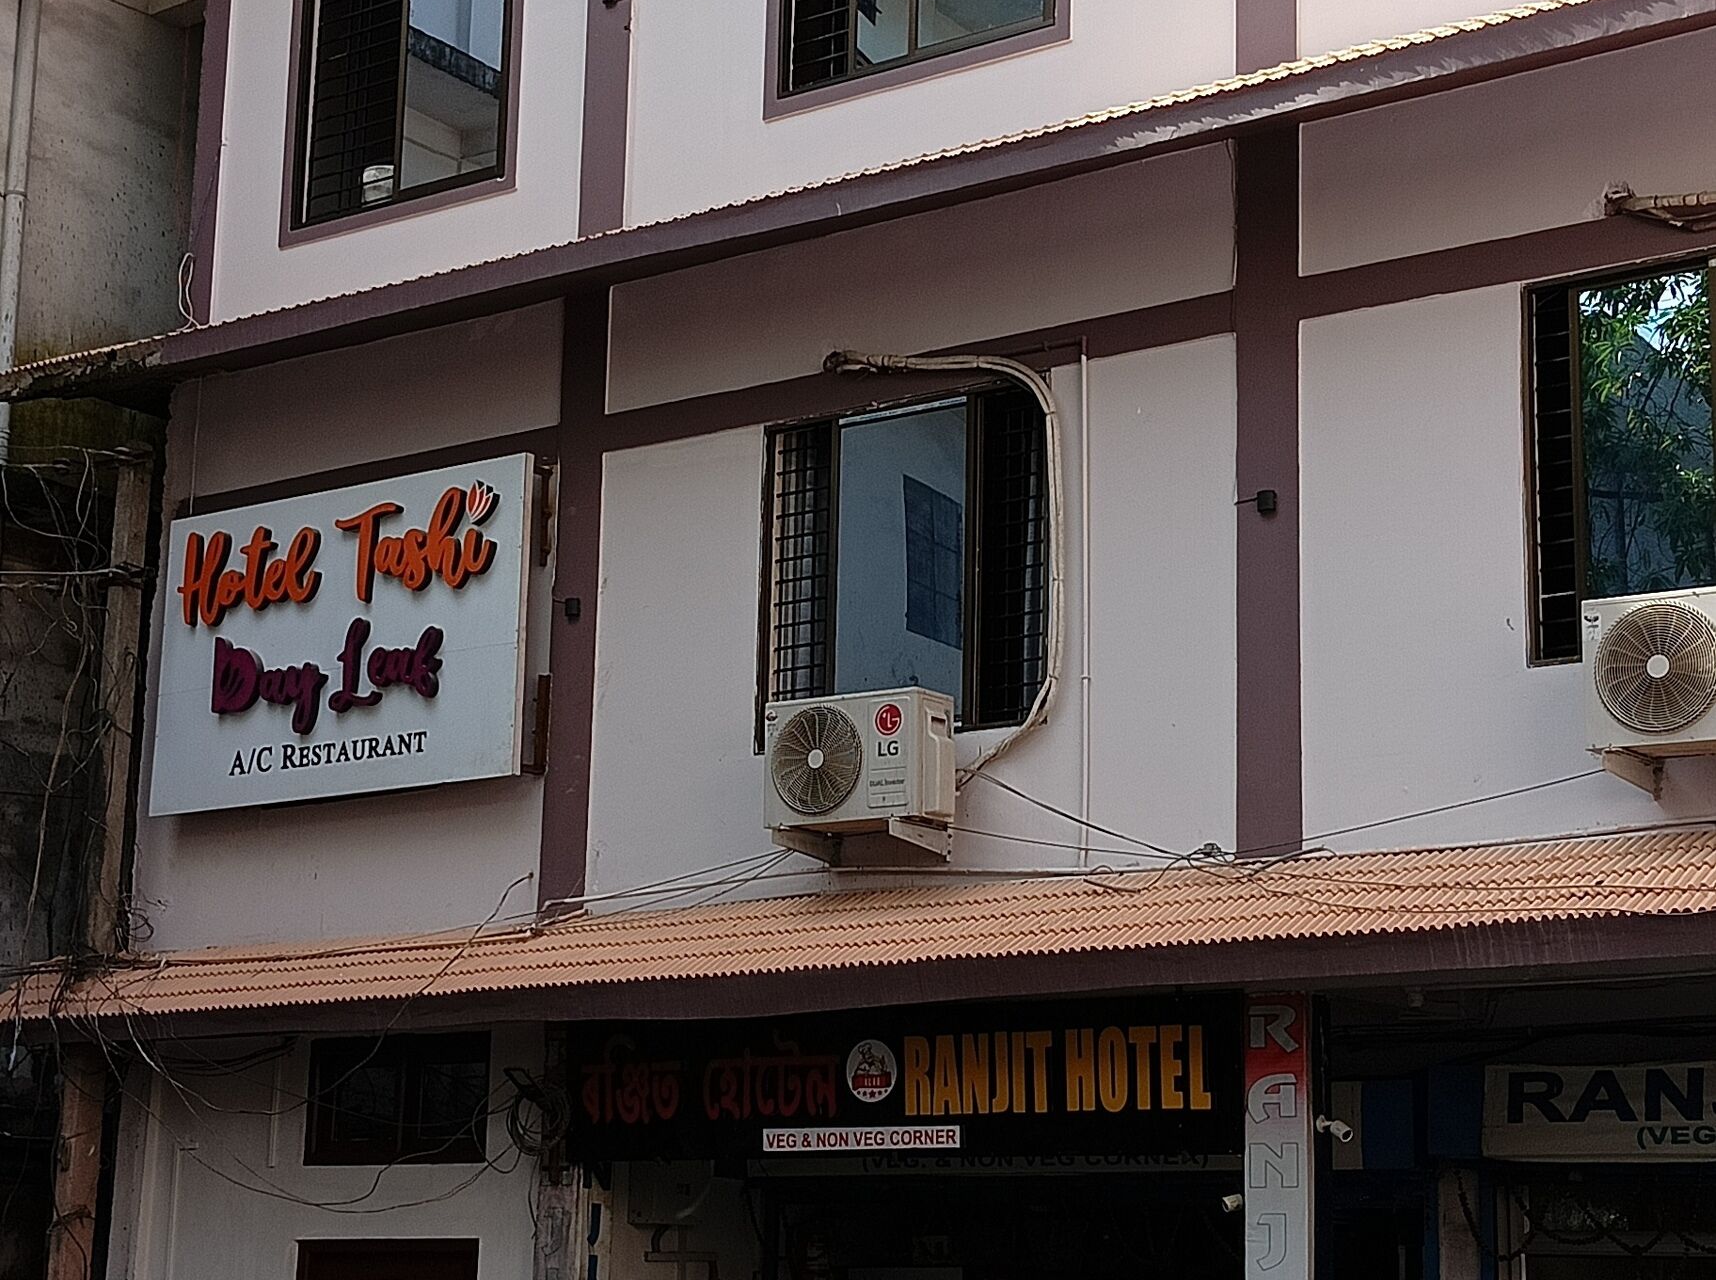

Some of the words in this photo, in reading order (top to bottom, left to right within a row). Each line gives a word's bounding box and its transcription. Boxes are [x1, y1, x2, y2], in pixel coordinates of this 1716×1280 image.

[177, 526, 323, 627] Hotel
[334, 482, 500, 604] Tashi
[328, 617, 445, 714] Leaf
[229, 747, 273, 777] A/C
[282, 731, 427, 771] RESTAURANT
[877, 740, 899, 757] LG
[702, 1027, 840, 1121] হোটেল
[904, 1029, 1054, 1117] RANJIT
[1064, 1023, 1212, 1114] HOTEL
[1507, 1067, 1716, 1124] RAN
[766, 1133, 797, 1149] VEG
[801, 1133, 812, 1148] &
[816, 1131, 849, 1148] NON
[853, 1130, 885, 1147] VEG
[889, 1128, 957, 1146] CORNER
